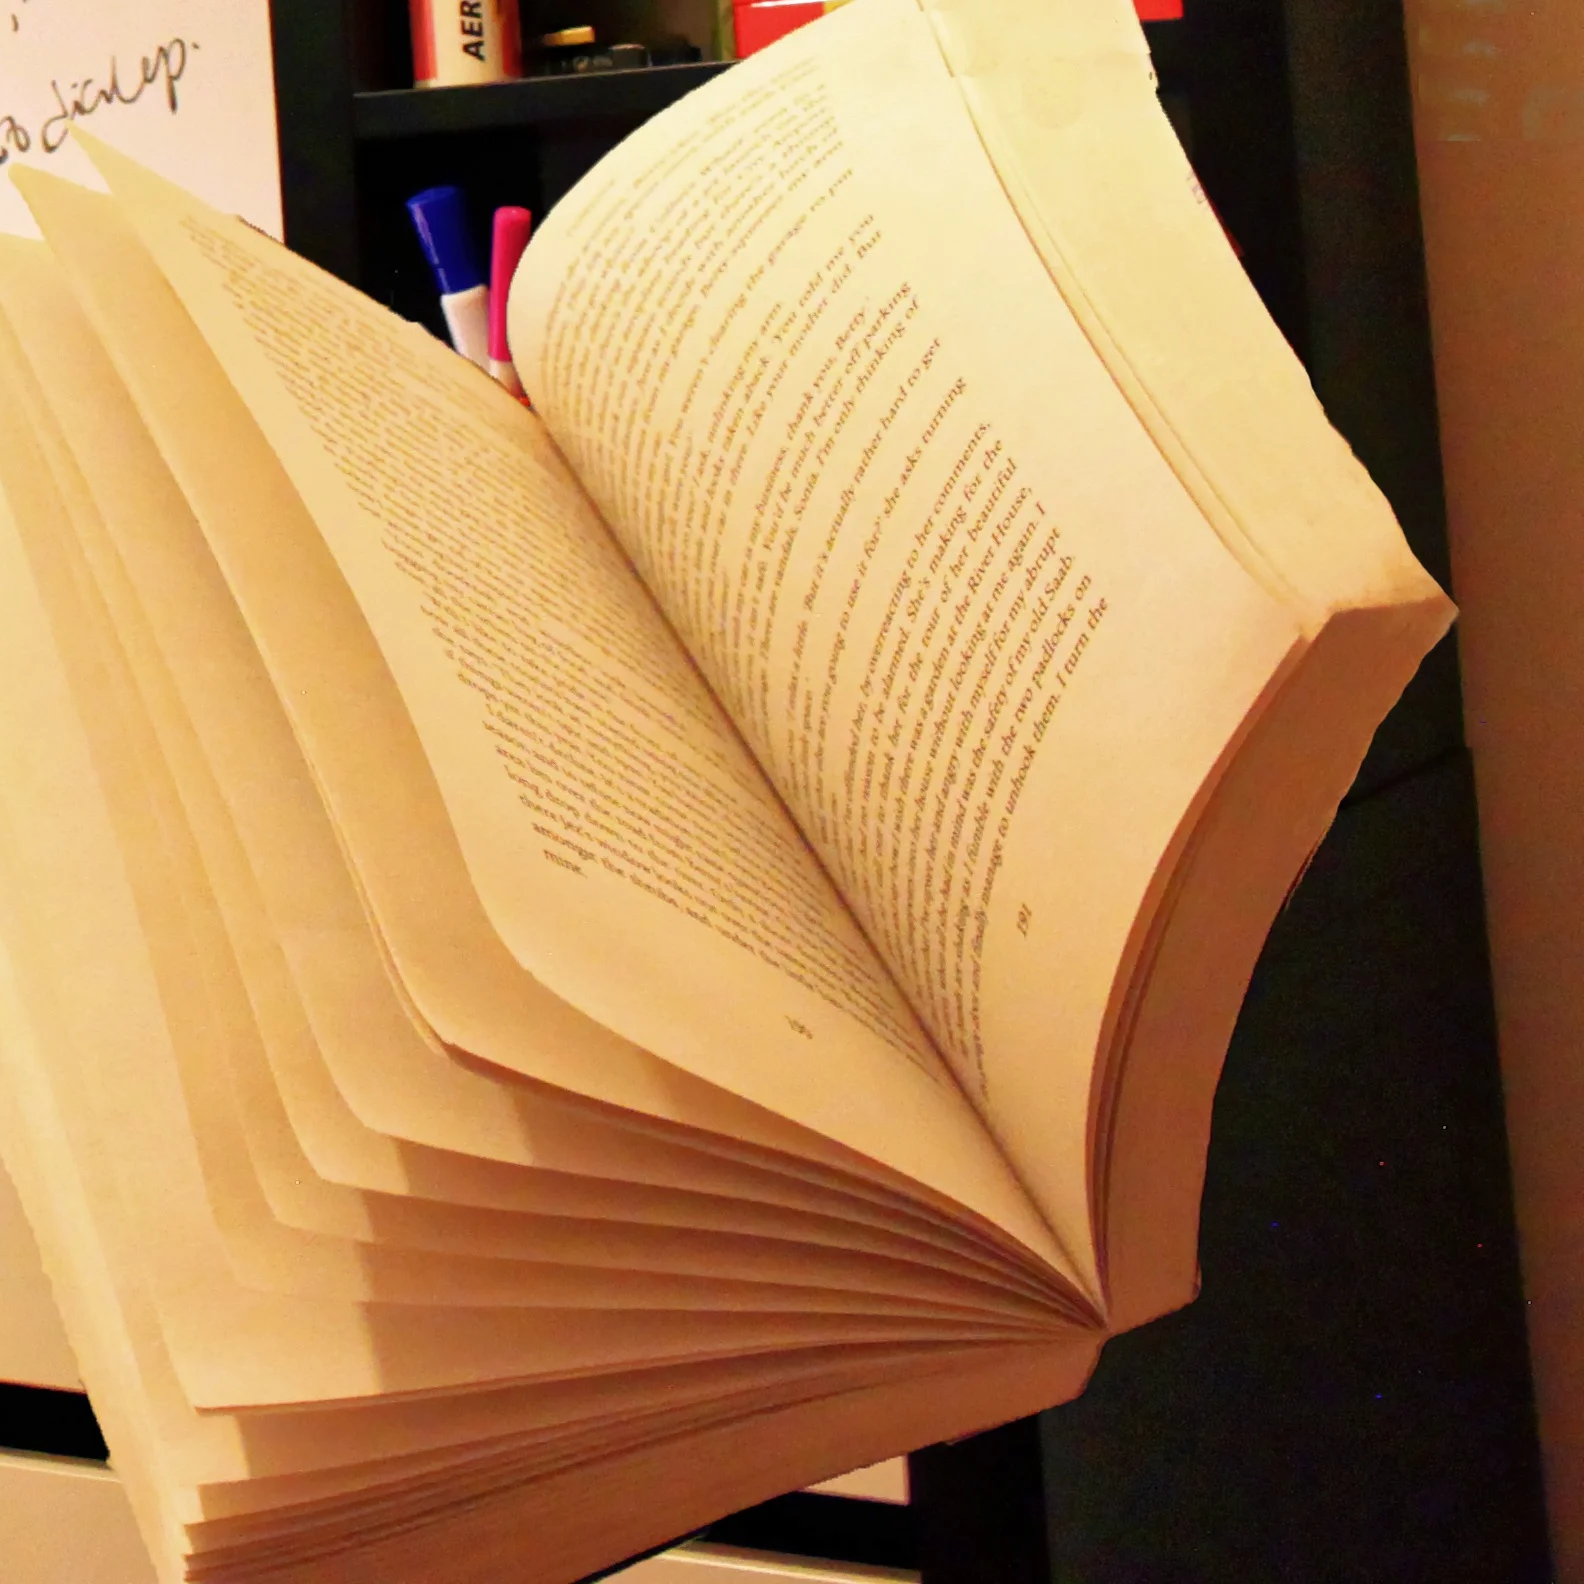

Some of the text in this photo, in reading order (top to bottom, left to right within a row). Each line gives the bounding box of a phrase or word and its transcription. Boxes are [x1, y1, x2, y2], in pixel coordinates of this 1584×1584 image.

[846, 578, 862, 609] use
[856, 559, 868, 578] it
[882, 487, 901, 519] she
[899, 446, 923, 486] asks
[921, 376, 967, 444] turning
[853, 336, 941, 484] rather hard to get
[906, 576, 931, 624] She's
[929, 505, 967, 574] making
[963, 473, 982, 503] for
[982, 439, 1002, 471] the
[869, 423, 991, 668] overreacting to her comments,
[908, 457, 1017, 682] the tour of her beautiful
[909, 487, 1033, 751] was garden the River House,
[929, 500, 1047, 759] without looking at me again. I
[941, 527, 1061, 799] angry with myself for my abrupt
[961, 555, 1075, 801] was the safety of my old Saab.
[964, 574, 1092, 865] fumble with the two padlocks on
[997, 597, 1108, 839] to unhook them. I turn the
[1016, 903, 1033, 938] 191
